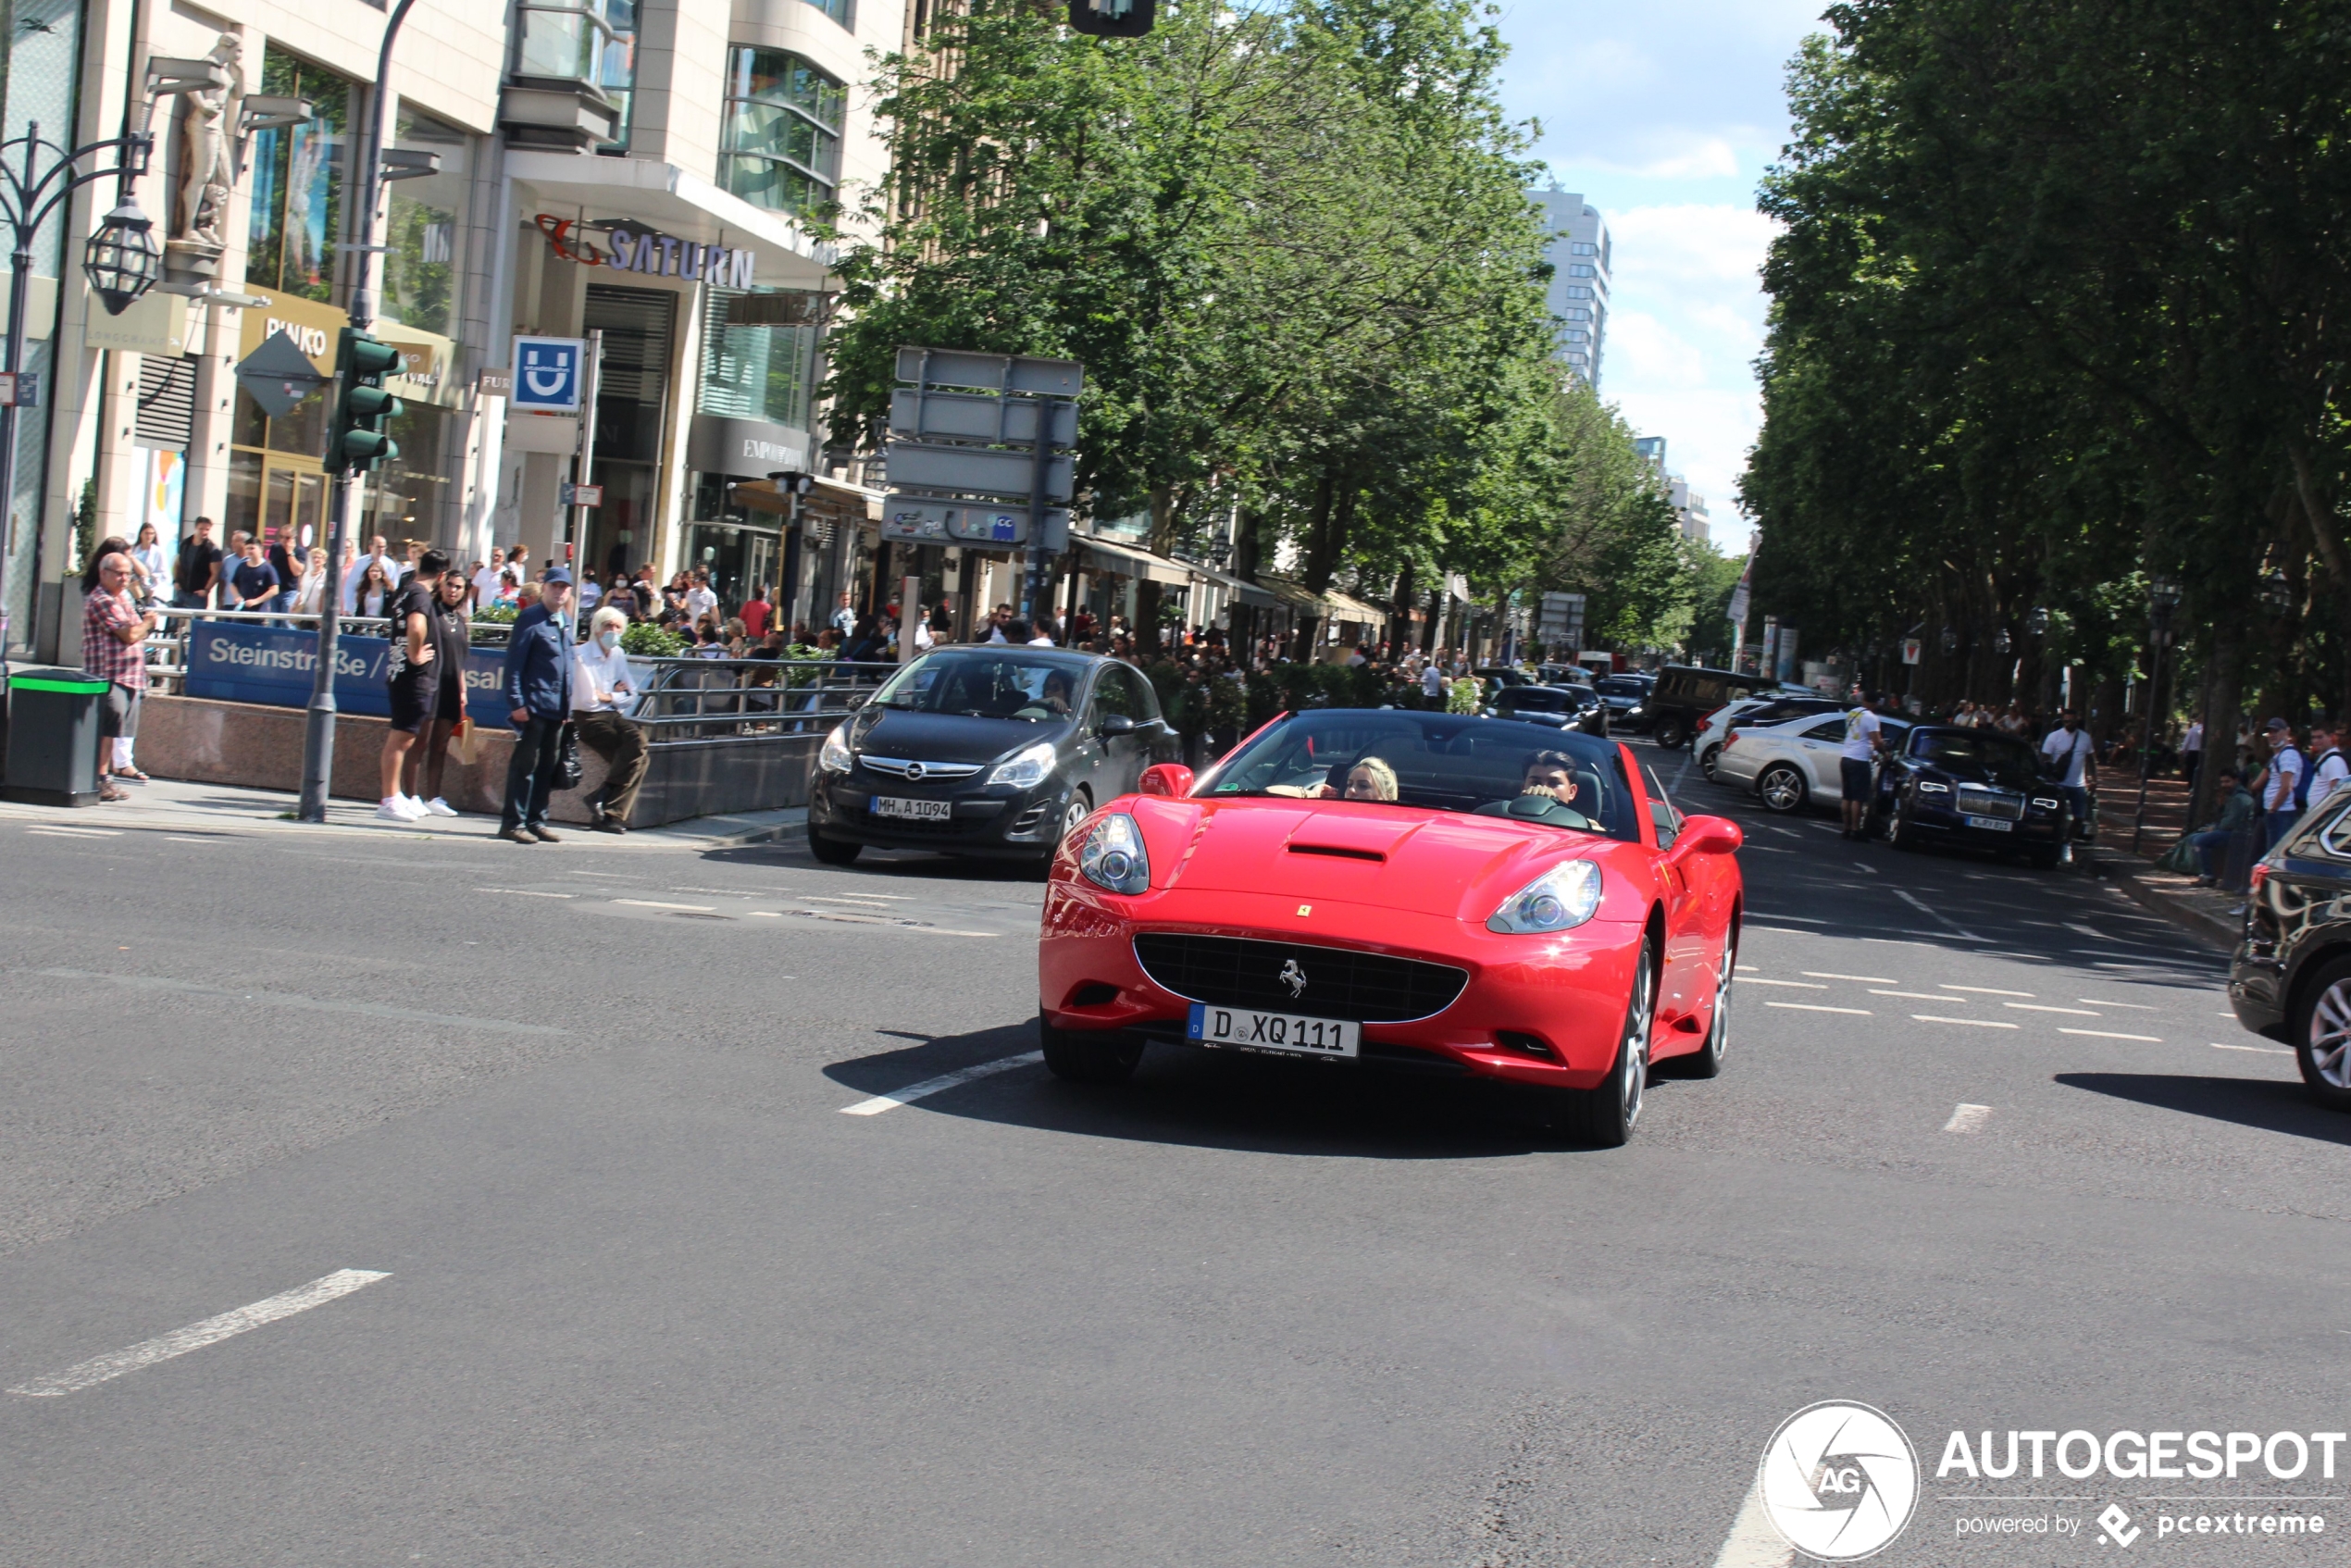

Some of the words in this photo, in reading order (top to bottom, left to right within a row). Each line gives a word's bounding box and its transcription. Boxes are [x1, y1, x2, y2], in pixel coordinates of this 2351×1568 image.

[608, 230, 755, 290] SATURN
[482, 376, 512, 389] FUR
[209, 638, 367, 677] Steinstrße
[878, 799, 896, 813] MH
[904, 801, 913, 815] A
[915, 802, 950, 817] 1094
[1213, 1011, 1232, 1038] D
